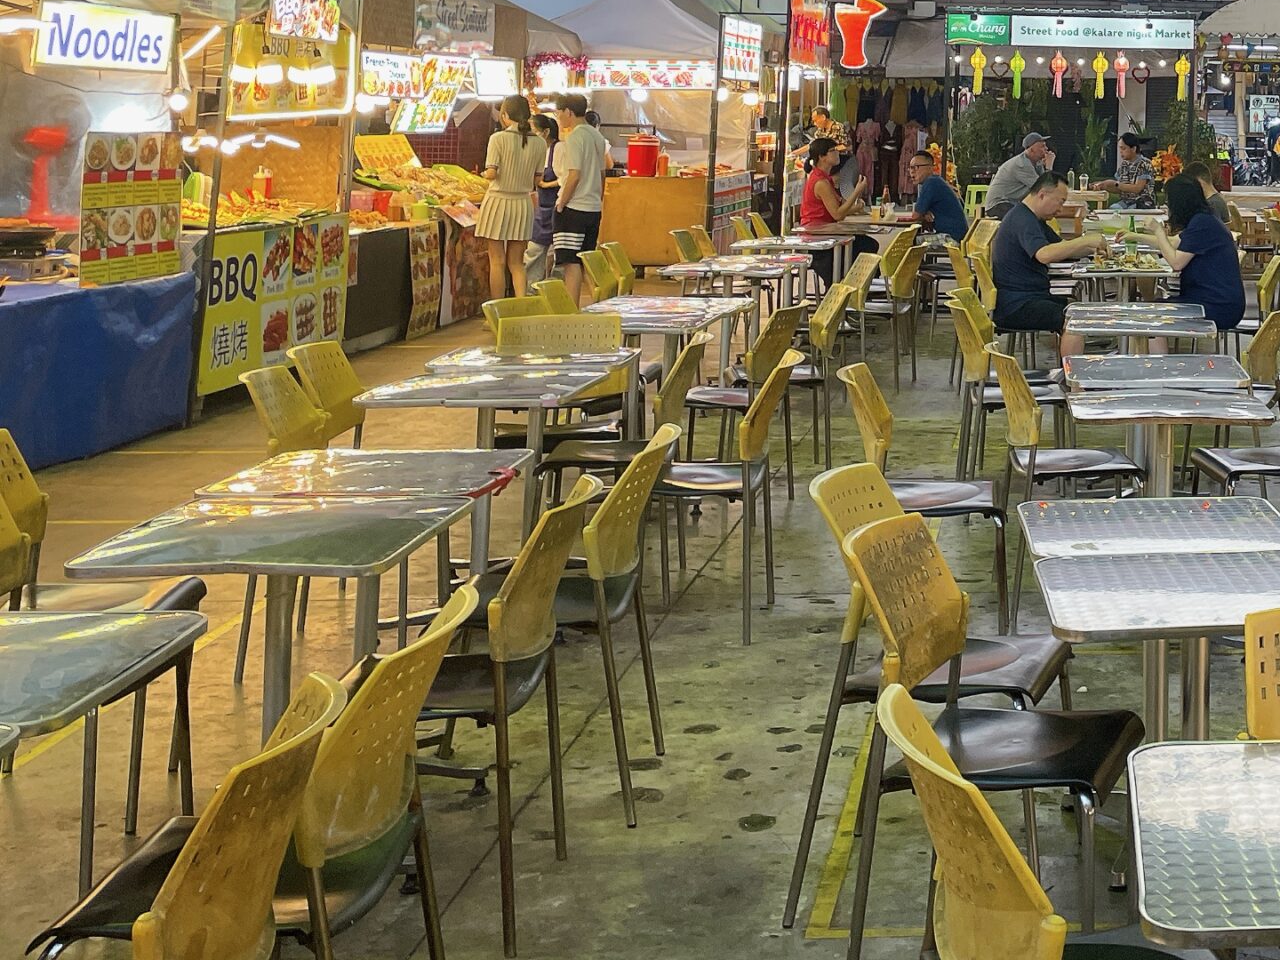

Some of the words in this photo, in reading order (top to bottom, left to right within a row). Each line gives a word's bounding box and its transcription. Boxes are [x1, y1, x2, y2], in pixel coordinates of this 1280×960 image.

[48, 13, 163, 64] Noodles
[968, 22, 1007, 35] Chang
[1020, 26, 1053, 36] Street
[1082, 27, 1124, 38] @kalare
[1155, 29, 1191, 39] Market
[208, 253, 258, 307] BBQ
[211, 320, 248, 370] 燒烤
